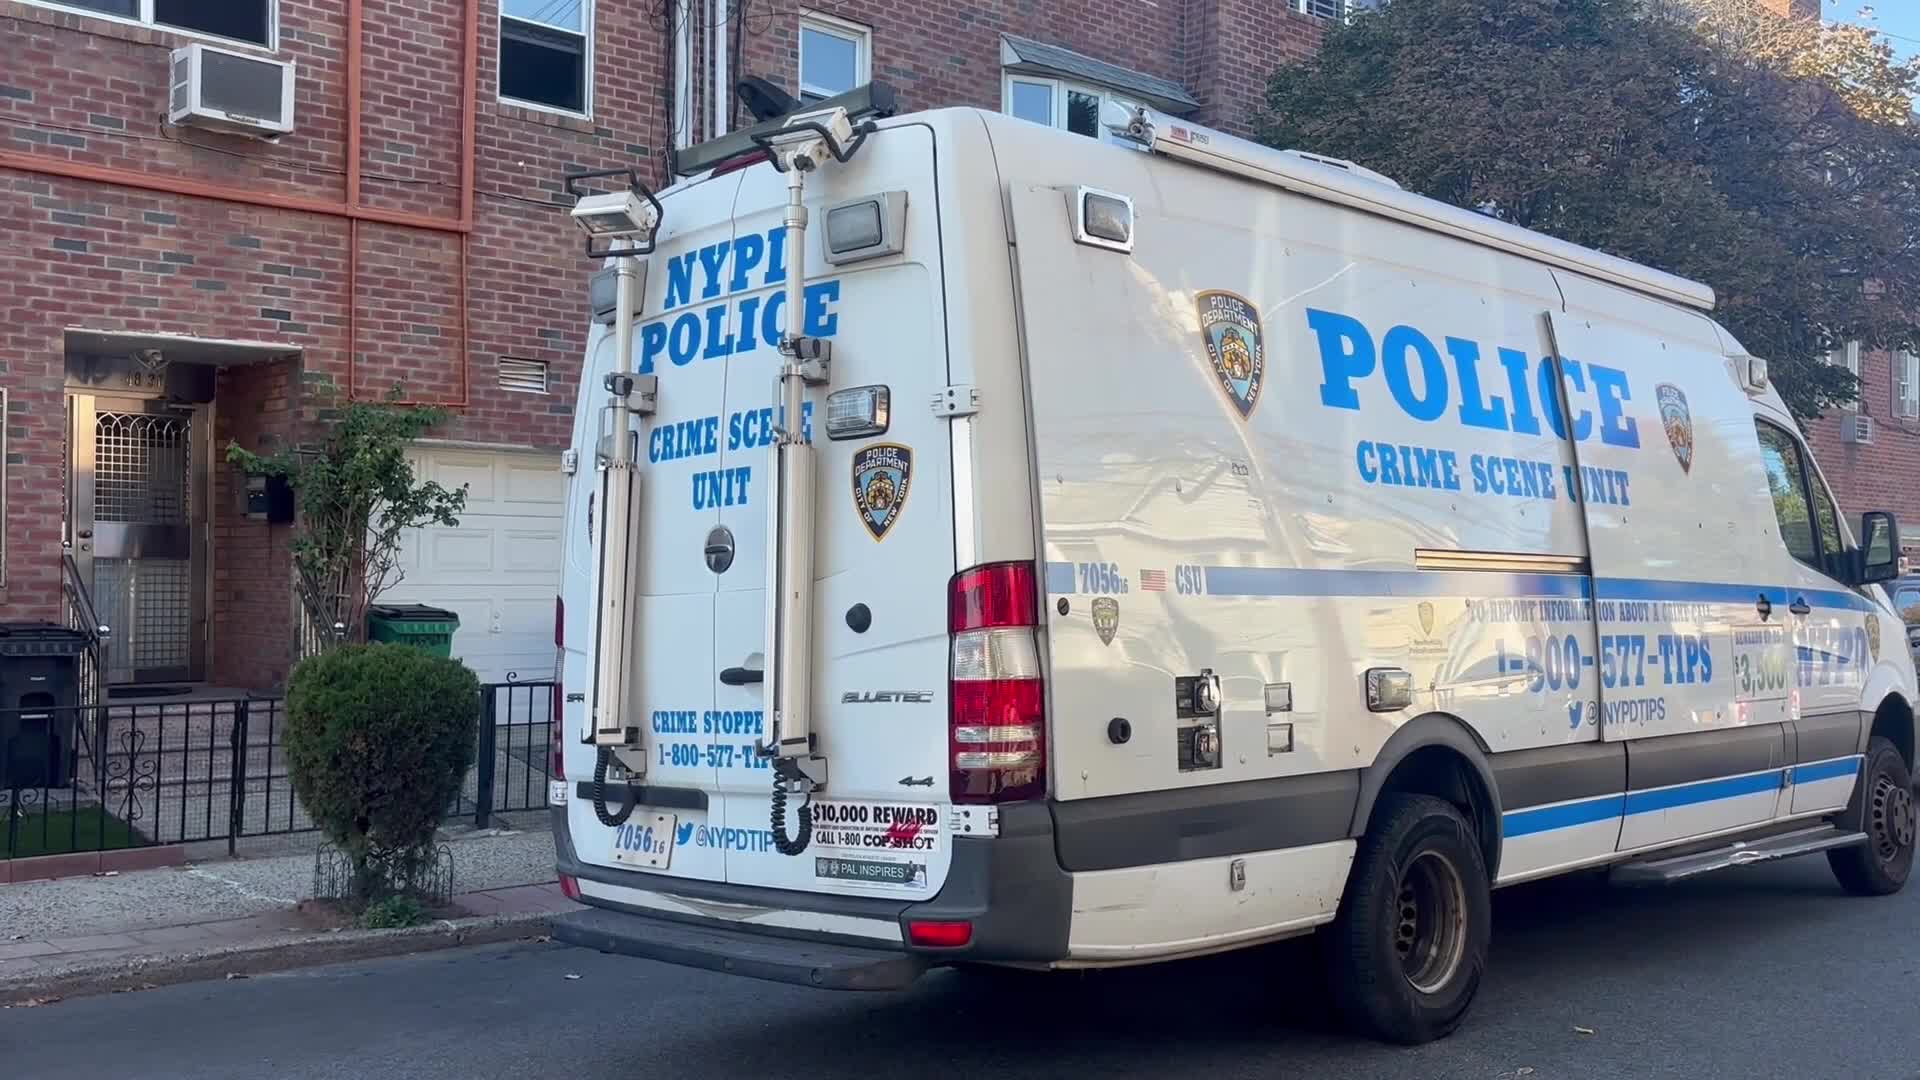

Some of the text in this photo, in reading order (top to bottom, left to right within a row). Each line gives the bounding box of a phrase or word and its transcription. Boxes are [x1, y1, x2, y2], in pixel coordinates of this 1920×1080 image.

[1210, 296, 1245, 314] POLICE
[638, 279, 840, 374] POLICE
[1202, 309, 1259, 336] DEPARTMENT
[1207, 343, 1263, 403] CITY OF NEW YORK
[1306, 307, 1640, 449] POLICE
[649, 401, 813, 464] CRIME SCEE
[855, 457, 909, 477] DEPARTMENT
[866, 447, 898, 460] POLICE
[1356, 440, 1631, 506] CRIME SCENE UNIT
[692, 467, 751, 511] UNIT
[855, 478, 908, 527] CITY OF NEW YORK
[1175, 564, 1201, 595] CSU
[1619, 602, 1649, 622] ABOUT
[841, 690, 935, 704] BLUETEC
[652, 711, 764, 734] CRIME STOPPE
[813, 801, 938, 826] $10,000 REWARD
[695, 824, 776, 853] @NYPDTIP
[815, 831, 836, 845] CALL
[838, 832, 861, 846] 1-800
[841, 863, 905, 879] PAL INSPIRES
